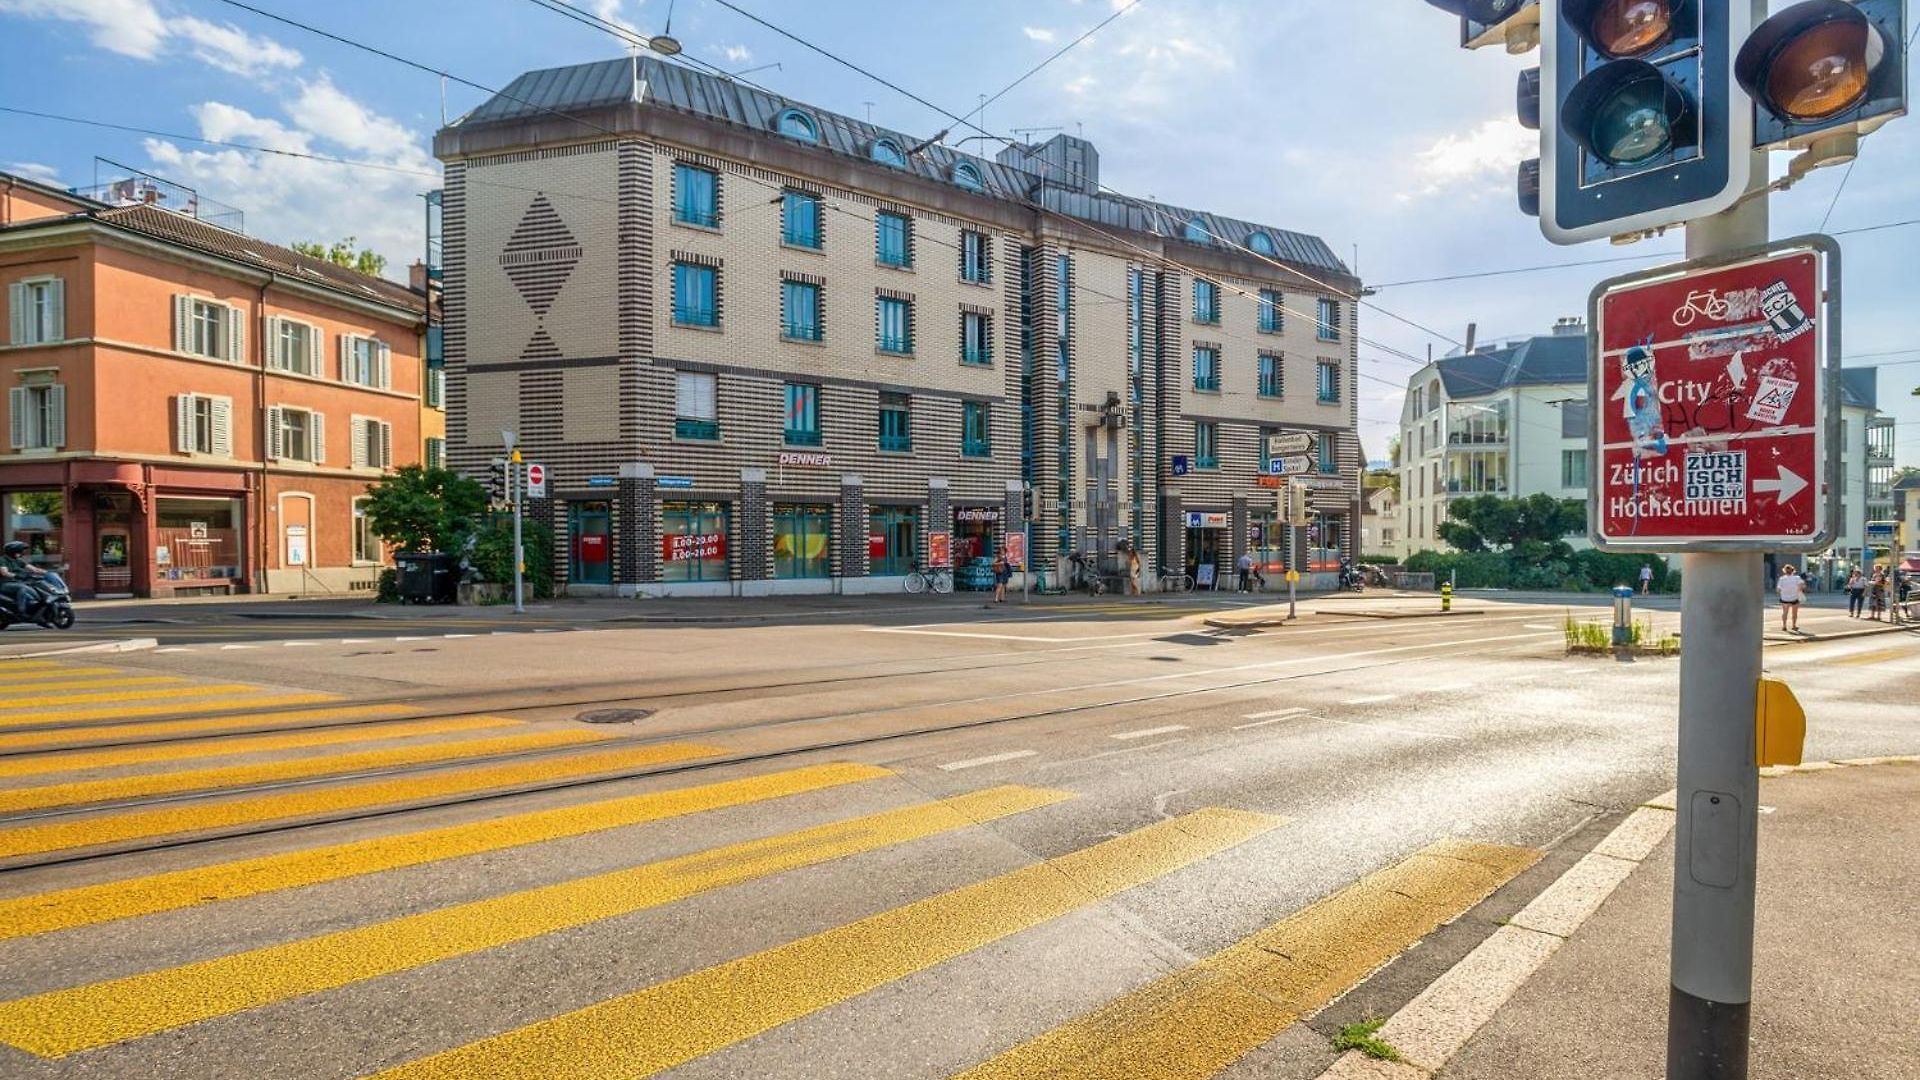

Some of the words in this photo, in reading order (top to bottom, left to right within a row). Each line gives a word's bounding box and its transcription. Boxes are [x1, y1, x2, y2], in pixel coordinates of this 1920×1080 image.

[1763, 294, 1794, 317] FCZ
[1658, 379, 1712, 407] City
[779, 453, 831, 466] DENNER
[1687, 452, 1742, 470] ZÜRI
[1610, 459, 1679, 486] Zürich
[1687, 469, 1742, 485] ISCH
[1686, 484, 1724, 498] OIS
[958, 511, 998, 520] DENNER
[1610, 495, 1747, 519] Hochschulen
